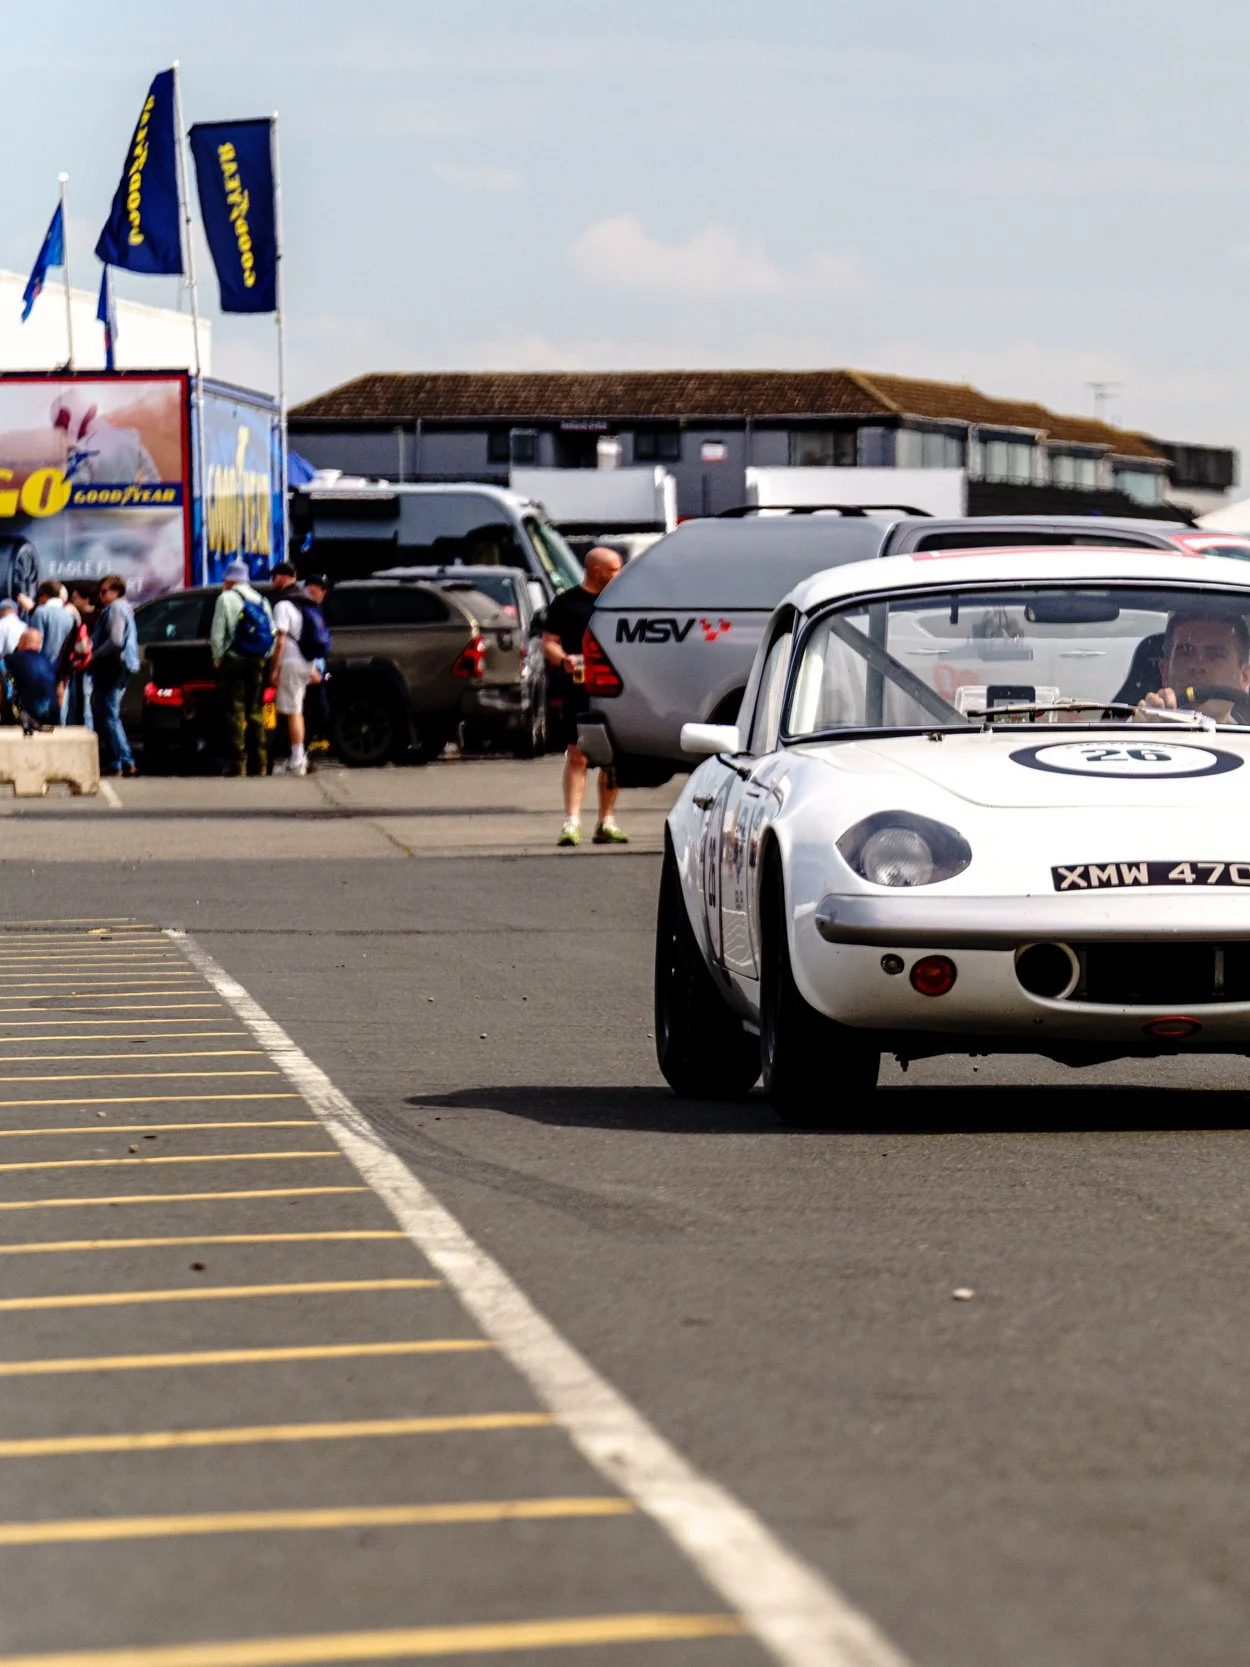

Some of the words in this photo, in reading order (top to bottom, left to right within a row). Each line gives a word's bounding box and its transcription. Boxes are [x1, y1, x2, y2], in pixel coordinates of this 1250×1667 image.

[74, 487, 176, 506] GOODYEAR
[615, 617, 696, 643] MSV
[1080, 748, 1173, 762] 26
[1057, 862, 1150, 890] XMW
